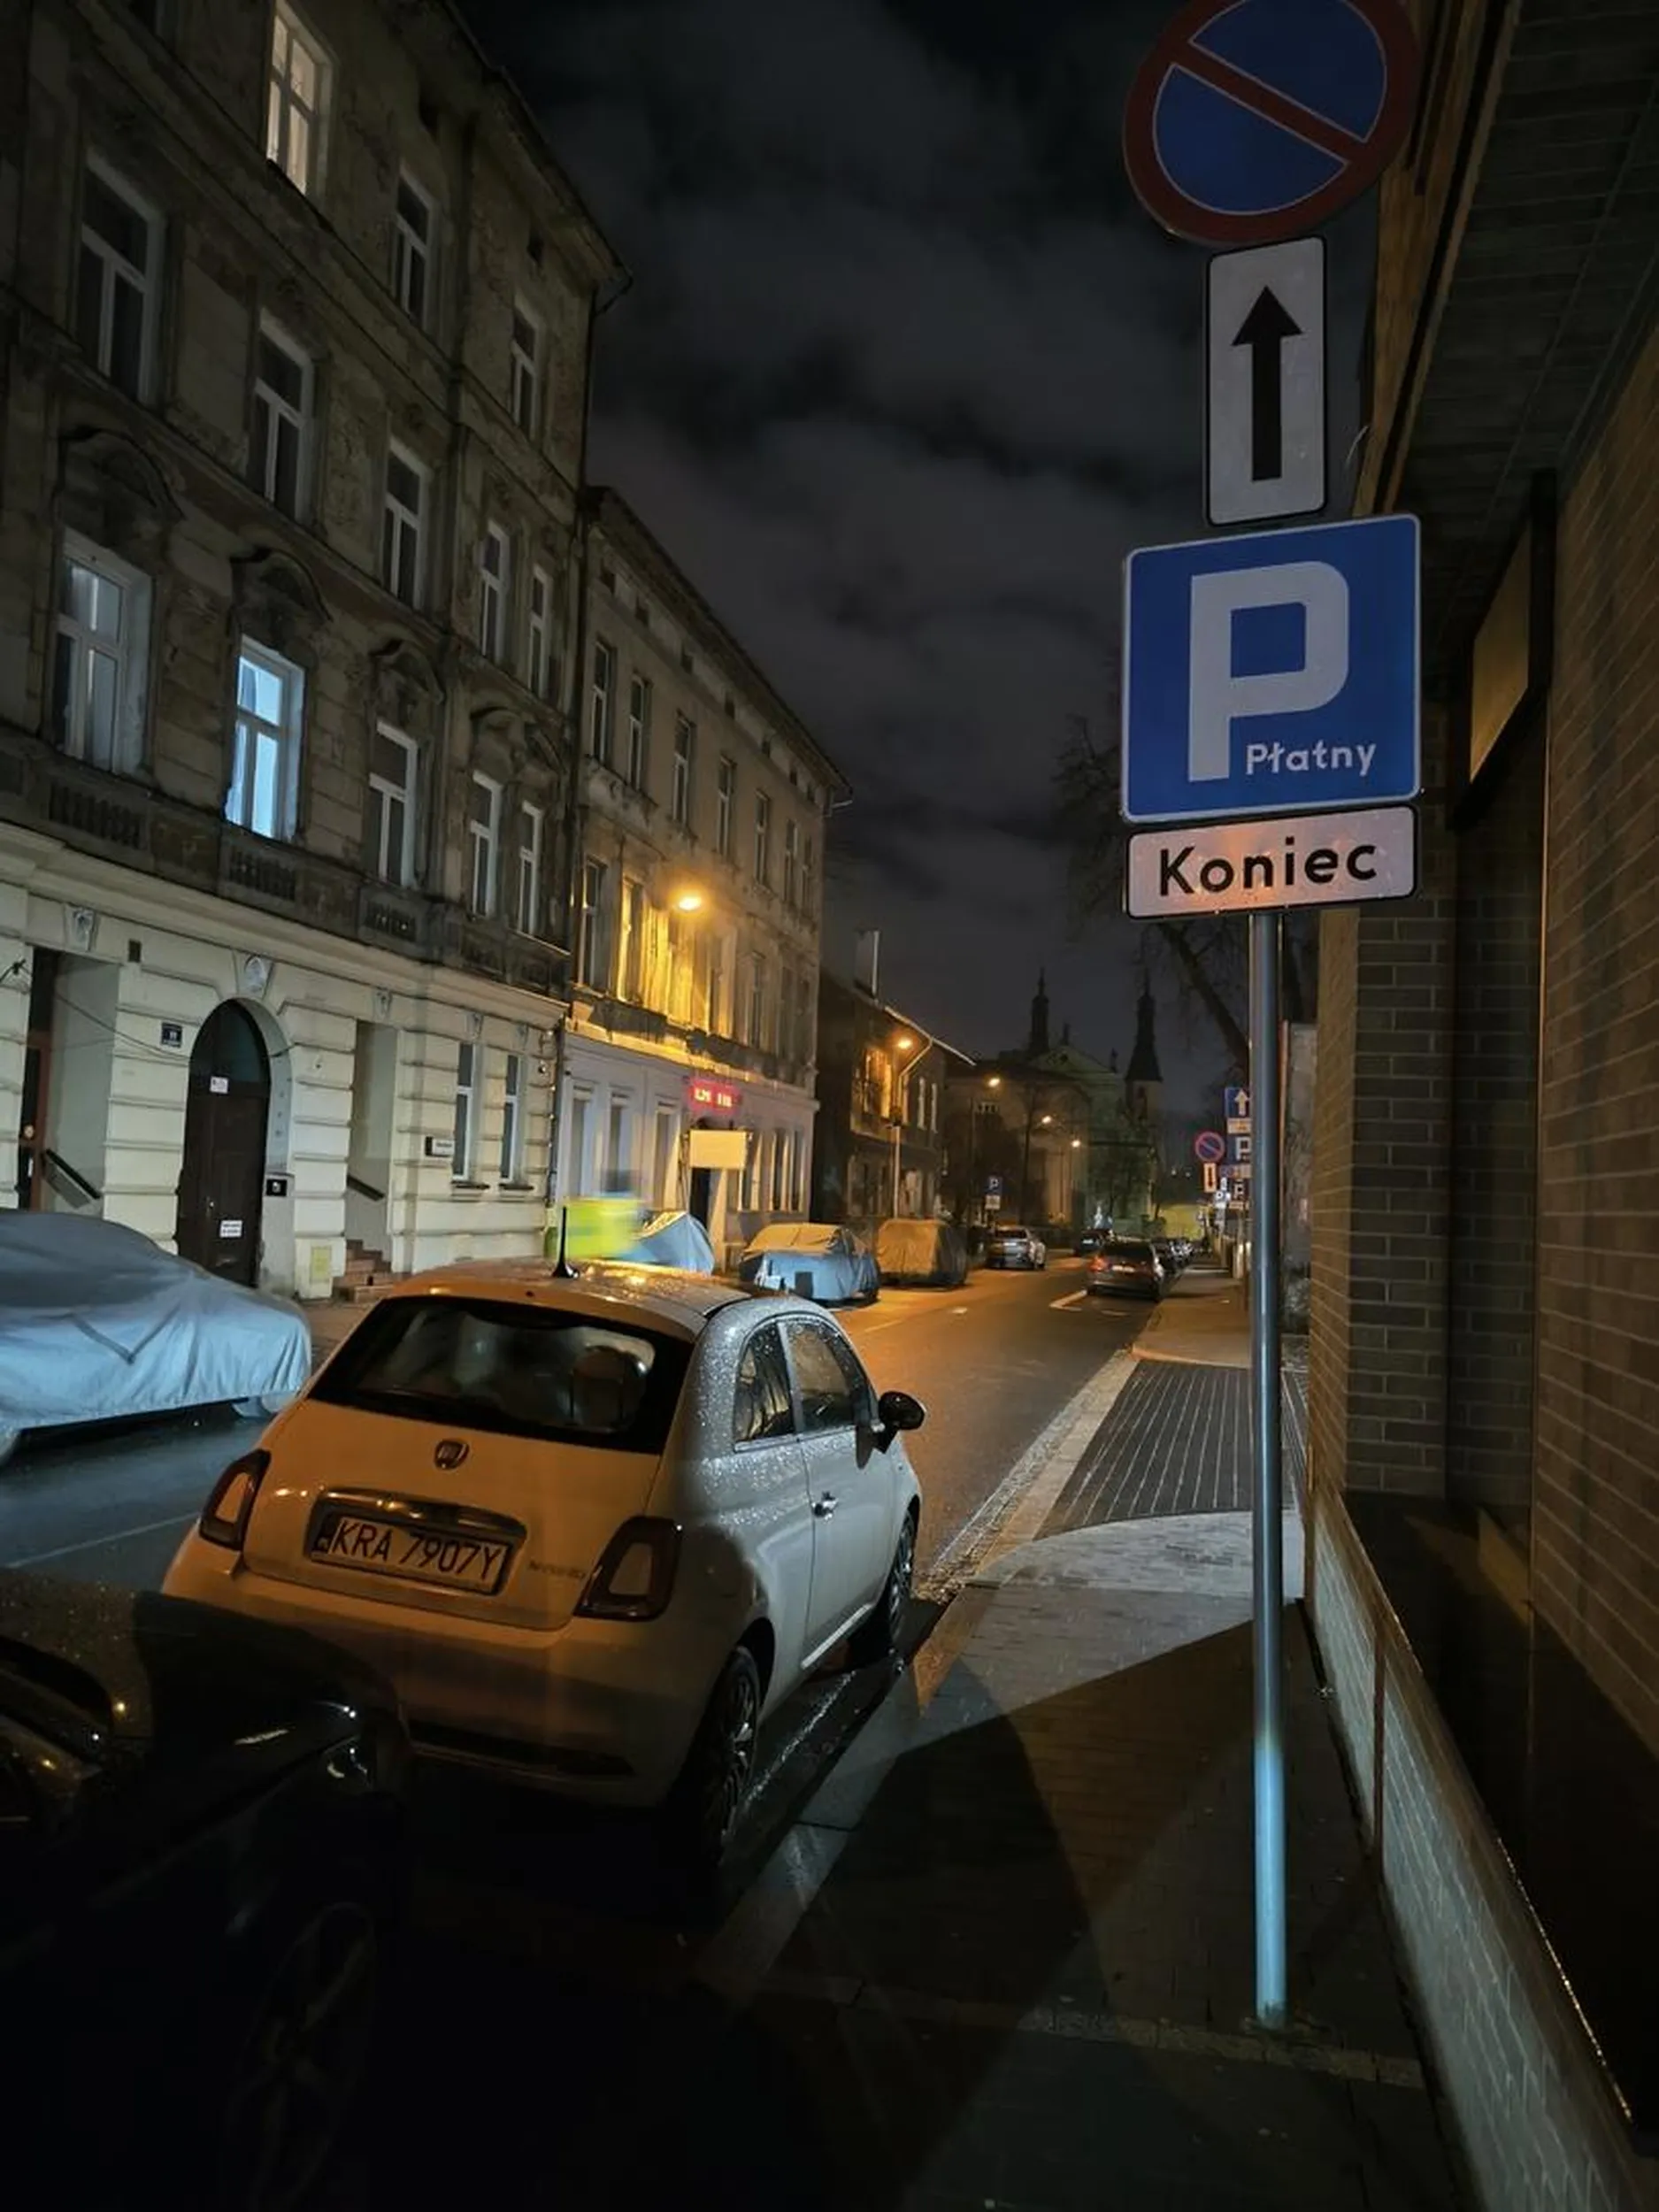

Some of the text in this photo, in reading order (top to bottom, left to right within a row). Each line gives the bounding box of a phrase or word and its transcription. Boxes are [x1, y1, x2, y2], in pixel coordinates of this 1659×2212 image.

[1188, 560, 1349, 782] P
[1245, 740, 1377, 776] Płatny
[1159, 836, 1378, 897] Koniec
[333, 1520, 393, 1562] KRA
[400, 1534, 502, 1580] 7907Y
